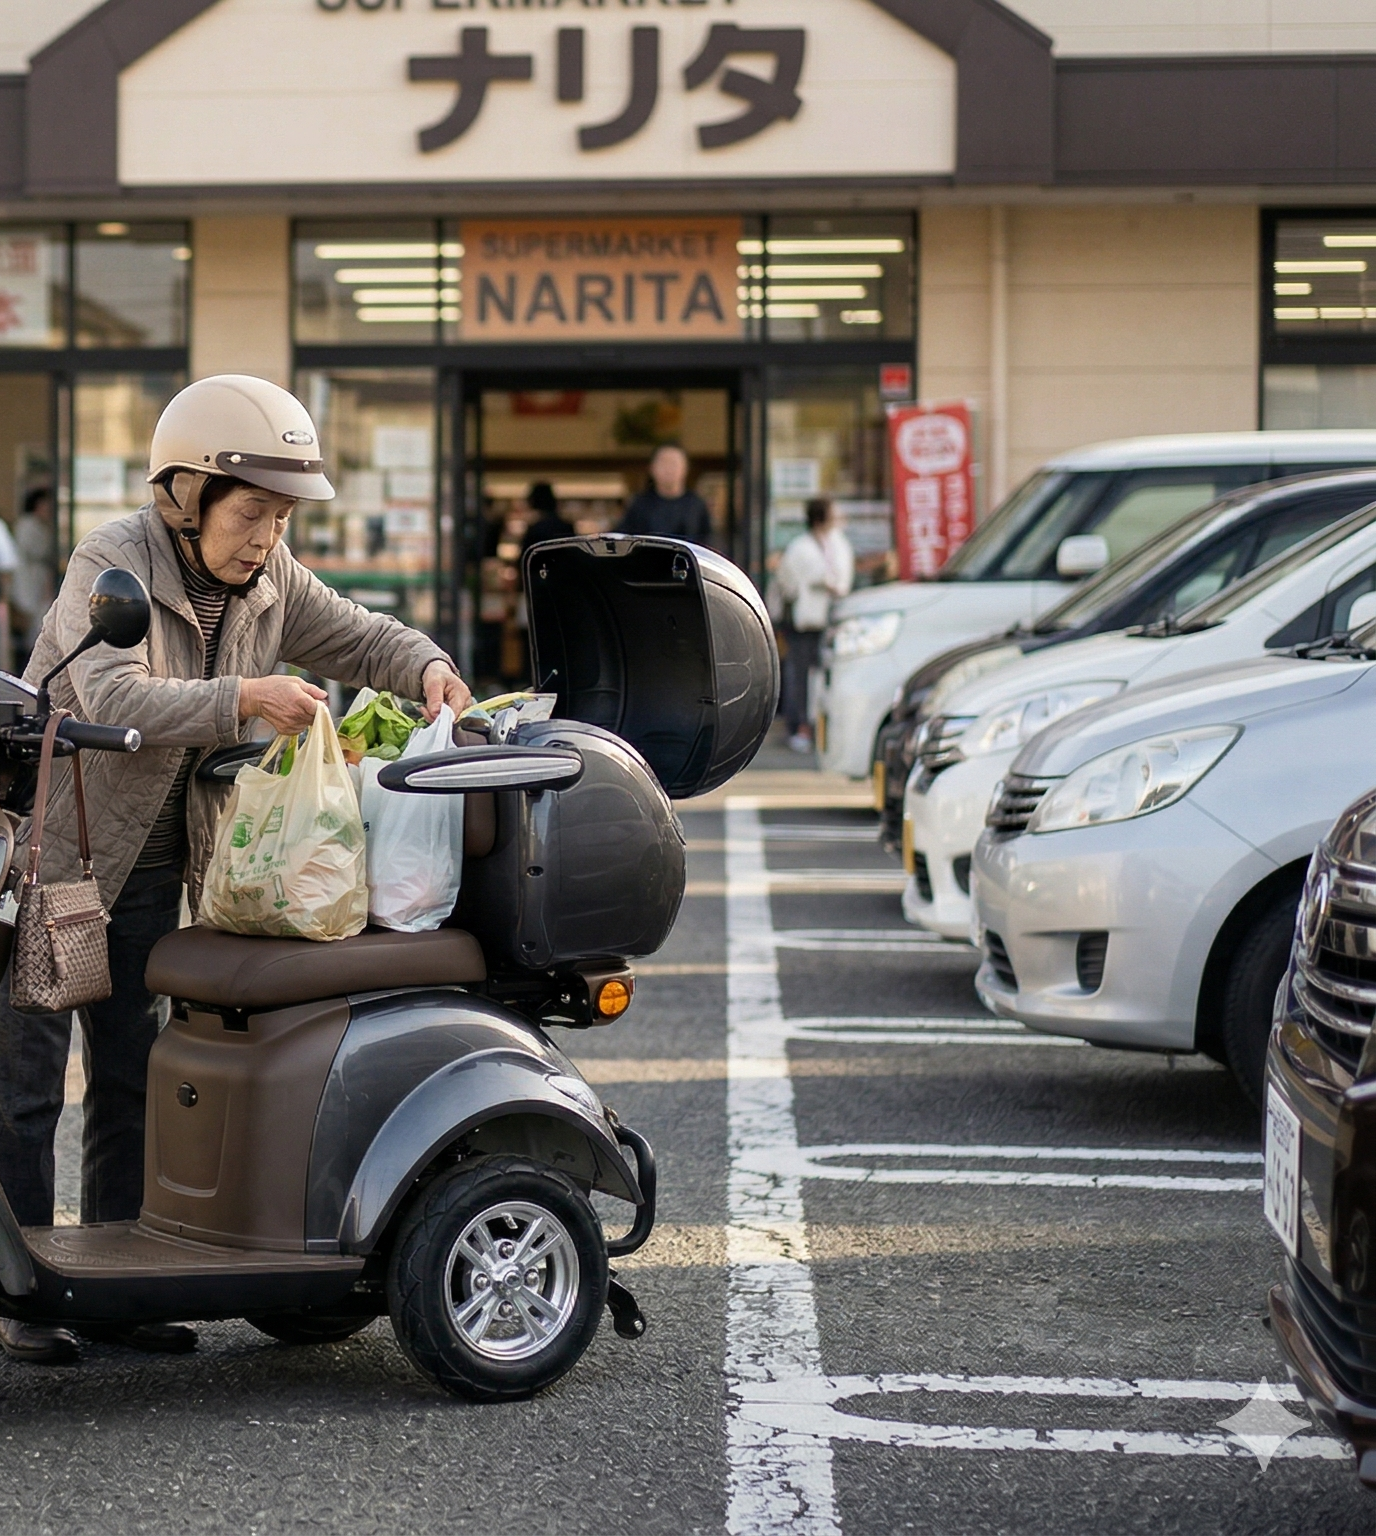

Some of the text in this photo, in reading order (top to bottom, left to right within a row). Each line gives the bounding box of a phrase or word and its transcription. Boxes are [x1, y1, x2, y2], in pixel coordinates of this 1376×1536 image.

[408, 24, 806, 154] ナリタ
[480, 231, 719, 260] SUPERMARKET
[477, 271, 725, 324] NARITA
